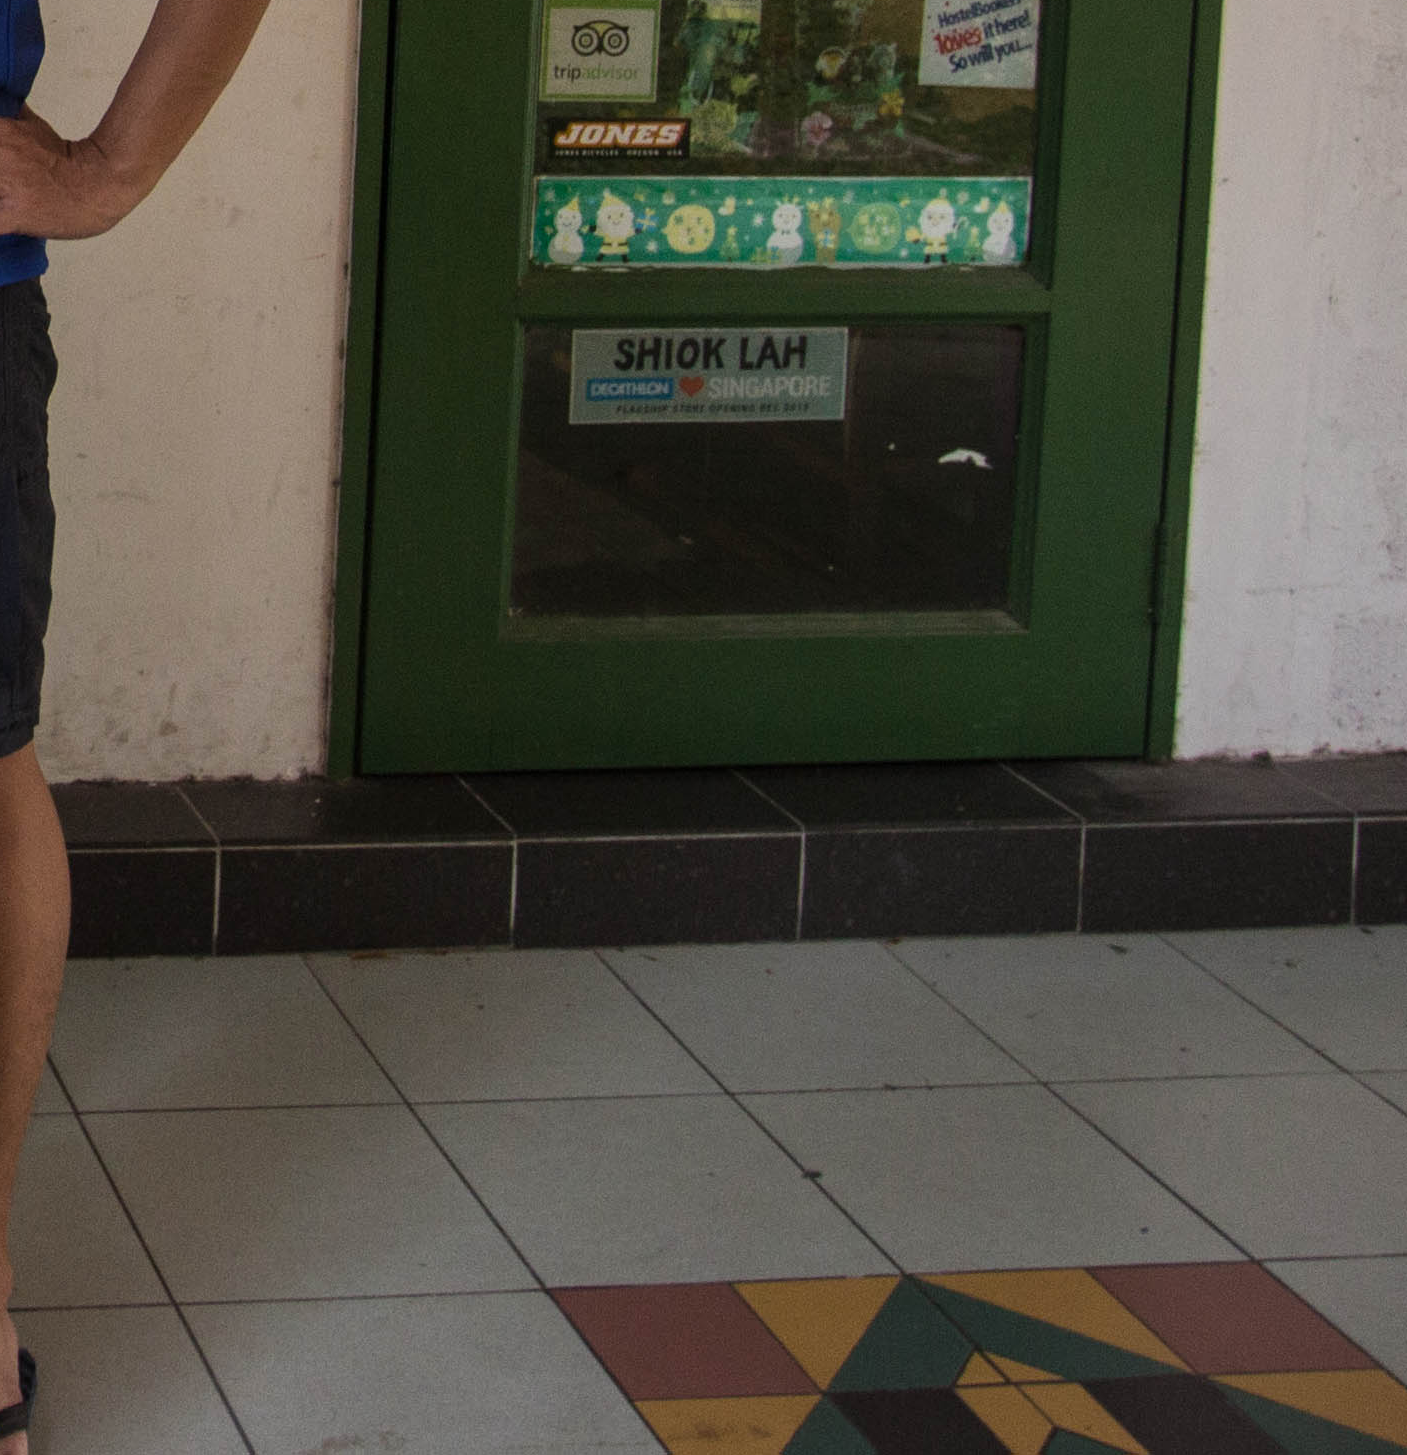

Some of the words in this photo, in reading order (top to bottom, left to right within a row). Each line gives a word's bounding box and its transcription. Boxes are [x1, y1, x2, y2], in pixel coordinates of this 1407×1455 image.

[934, 27, 984, 55] loves
[994, 8, 1032, 36] here!
[949, 53, 968, 73] So
[967, 43, 995, 66] will
[553, 63, 639, 83] tripadvisor
[554, 121, 688, 148] JONES
[613, 337, 729, 372] SHIOK
[738, 335, 808, 371] LAH
[708, 375, 832, 399] SINGAPORE
